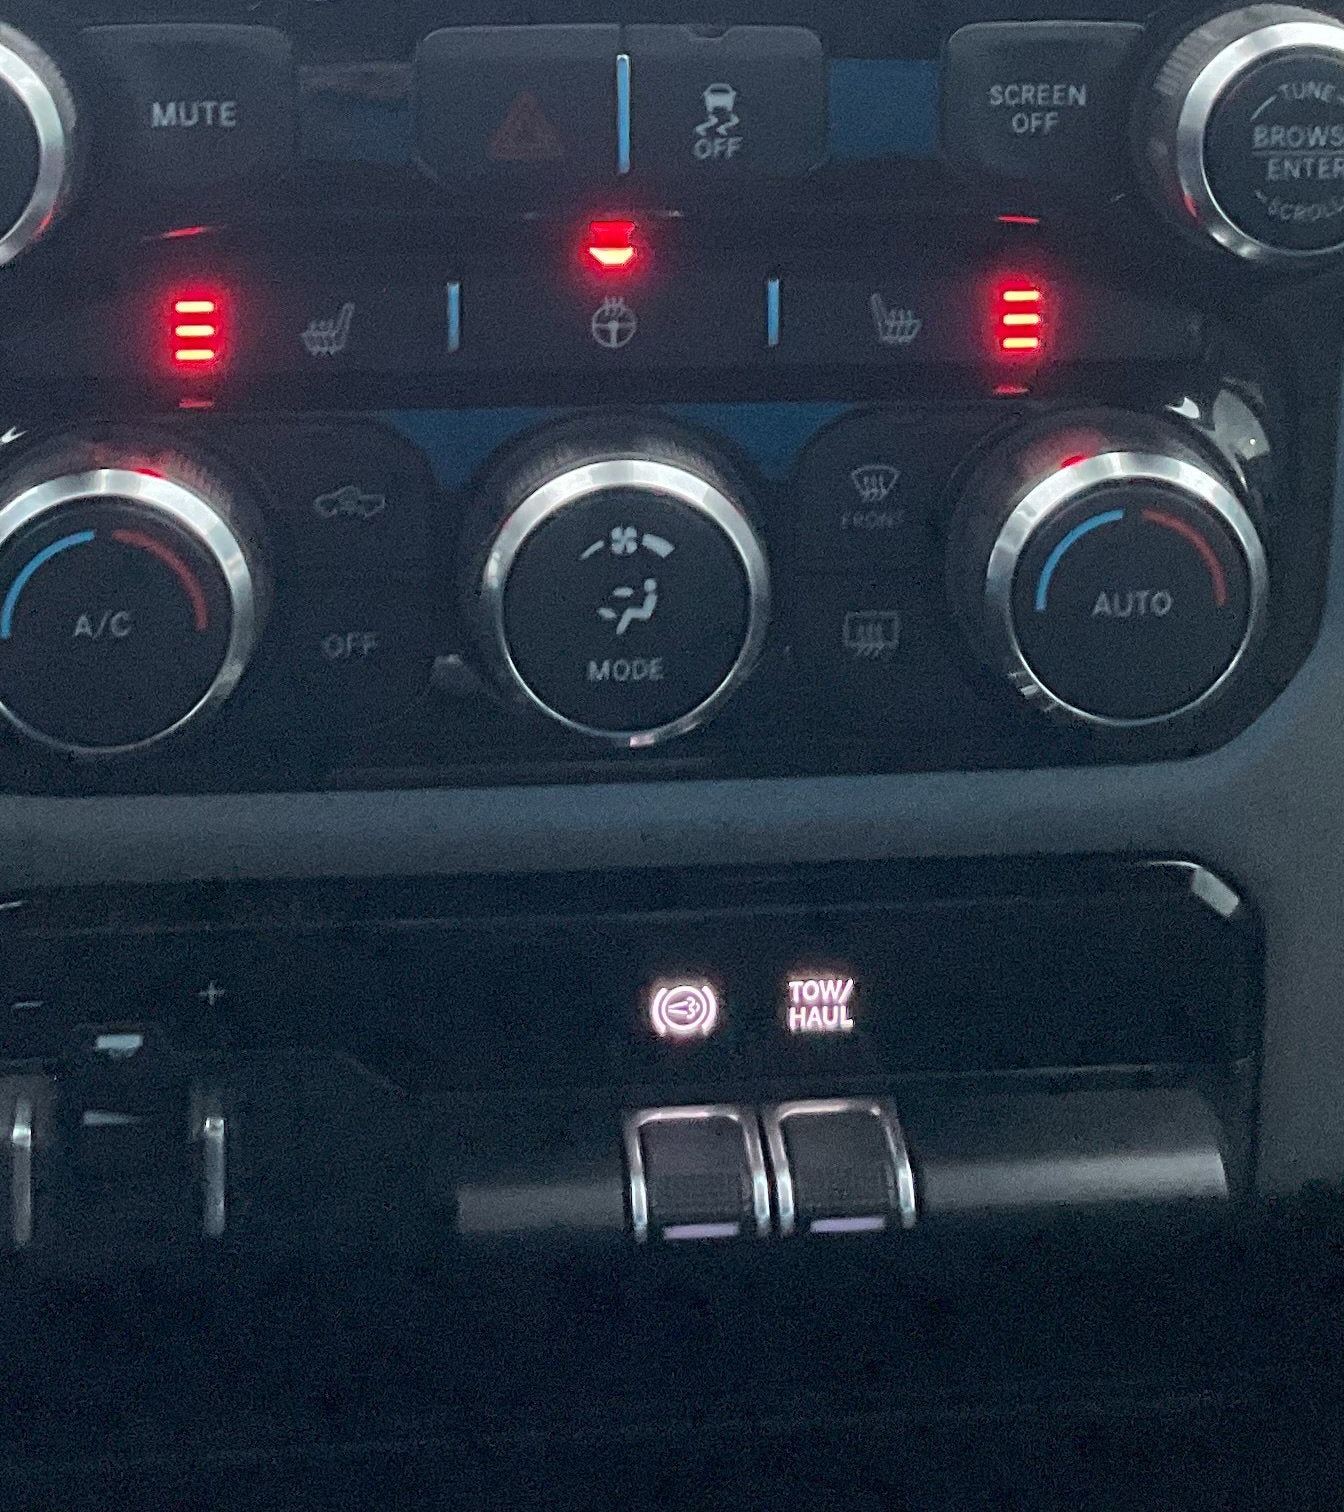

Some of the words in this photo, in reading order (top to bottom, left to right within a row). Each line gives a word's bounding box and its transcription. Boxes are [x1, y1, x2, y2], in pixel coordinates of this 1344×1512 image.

[989, 85, 1087, 107] SCREEN
[1278, 81, 1336, 104] TUNE
[152, 101, 237, 128] MUTE
[1011, 113, 1059, 135] OFF
[693, 136, 743, 160] OFF
[1092, 591, 1172, 617] AUTO
[73, 610, 132, 638] A/C
[322, 634, 379, 659] OFF
[587, 658, 664, 682] MODE
[788, 1005, 854, 1031] HAUL
